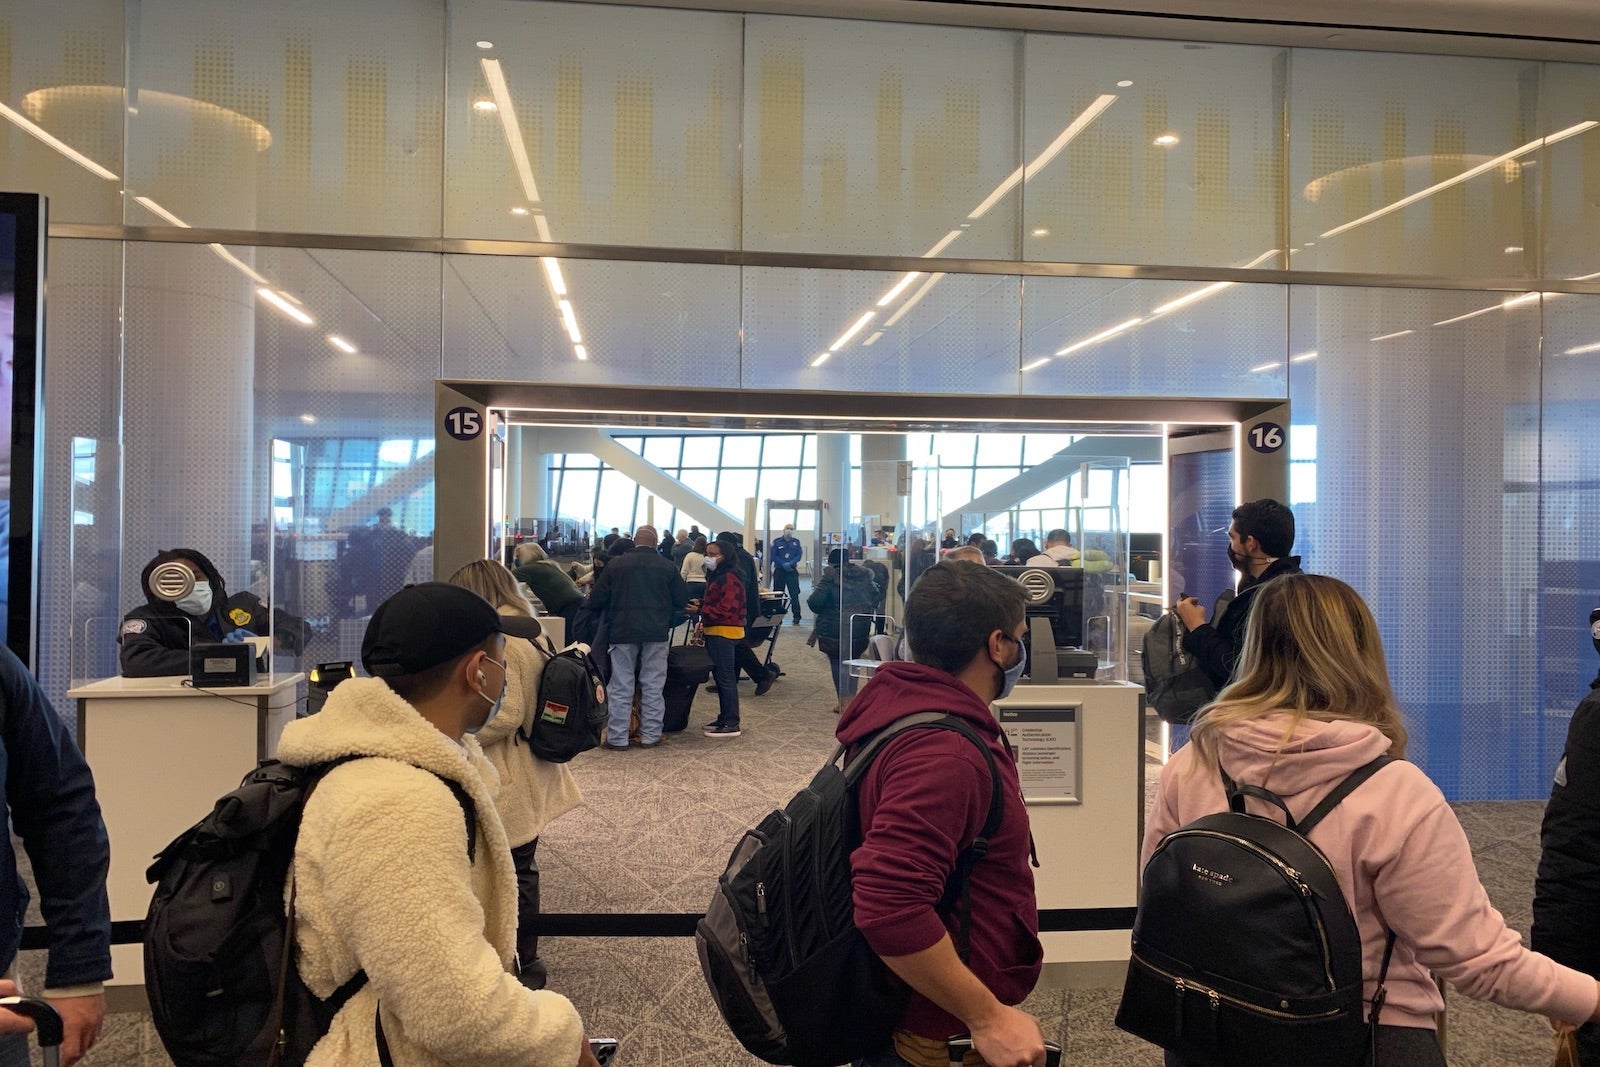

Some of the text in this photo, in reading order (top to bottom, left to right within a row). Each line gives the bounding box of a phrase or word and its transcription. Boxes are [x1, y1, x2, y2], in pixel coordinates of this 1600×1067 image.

[449, 412, 480, 435] 15
[1252, 427, 1282, 448] 16
[1192, 863, 1209, 875] kate
